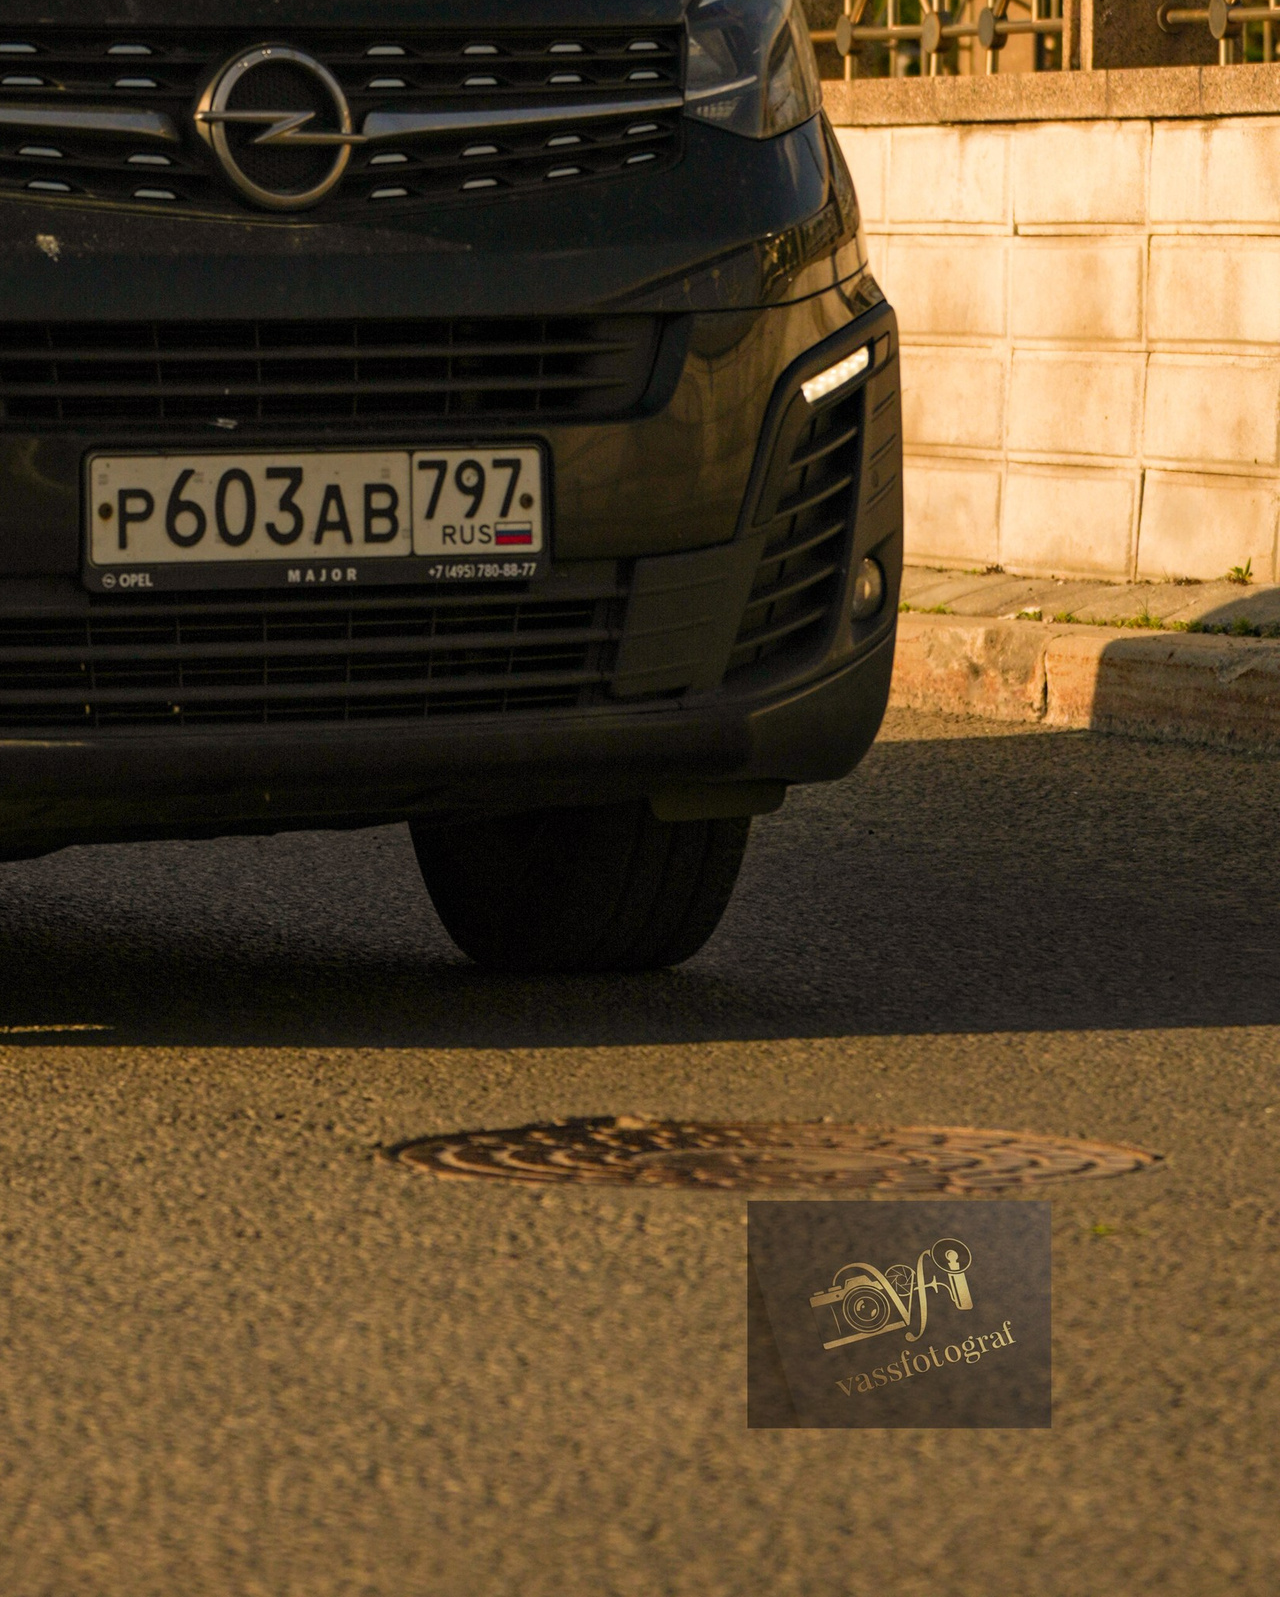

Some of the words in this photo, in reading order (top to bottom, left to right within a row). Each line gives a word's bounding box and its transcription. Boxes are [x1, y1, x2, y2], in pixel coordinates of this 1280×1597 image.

[418, 459, 522, 520] 797
[442, 525, 492, 545] RUS
[287, 568, 358, 583] MAJOR
[477, 562, 537, 578] 780-88-77
[119, 573, 153, 588] OPEL
